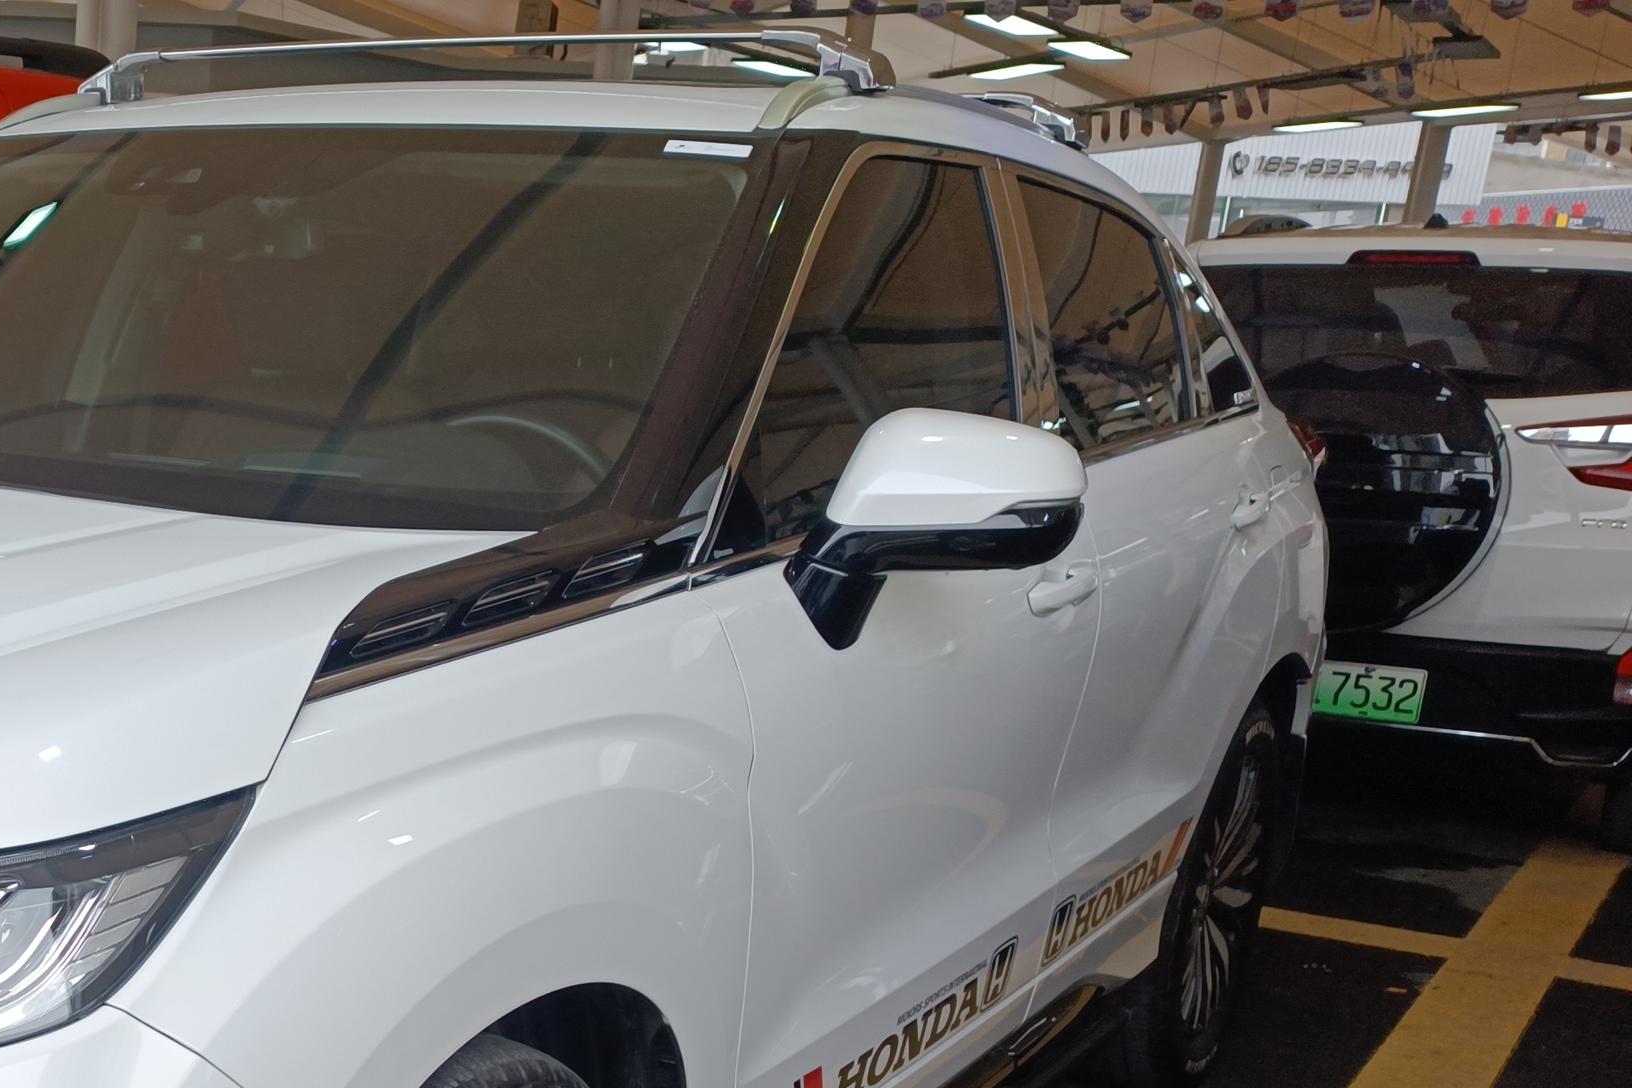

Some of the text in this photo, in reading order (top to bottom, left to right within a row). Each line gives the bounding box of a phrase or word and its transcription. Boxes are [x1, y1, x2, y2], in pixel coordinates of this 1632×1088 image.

[1256, 155, 1453, 179] 185-8334-44
[1314, 670, 1419, 715] 7532
[1067, 850, 1162, 948] HONDA
